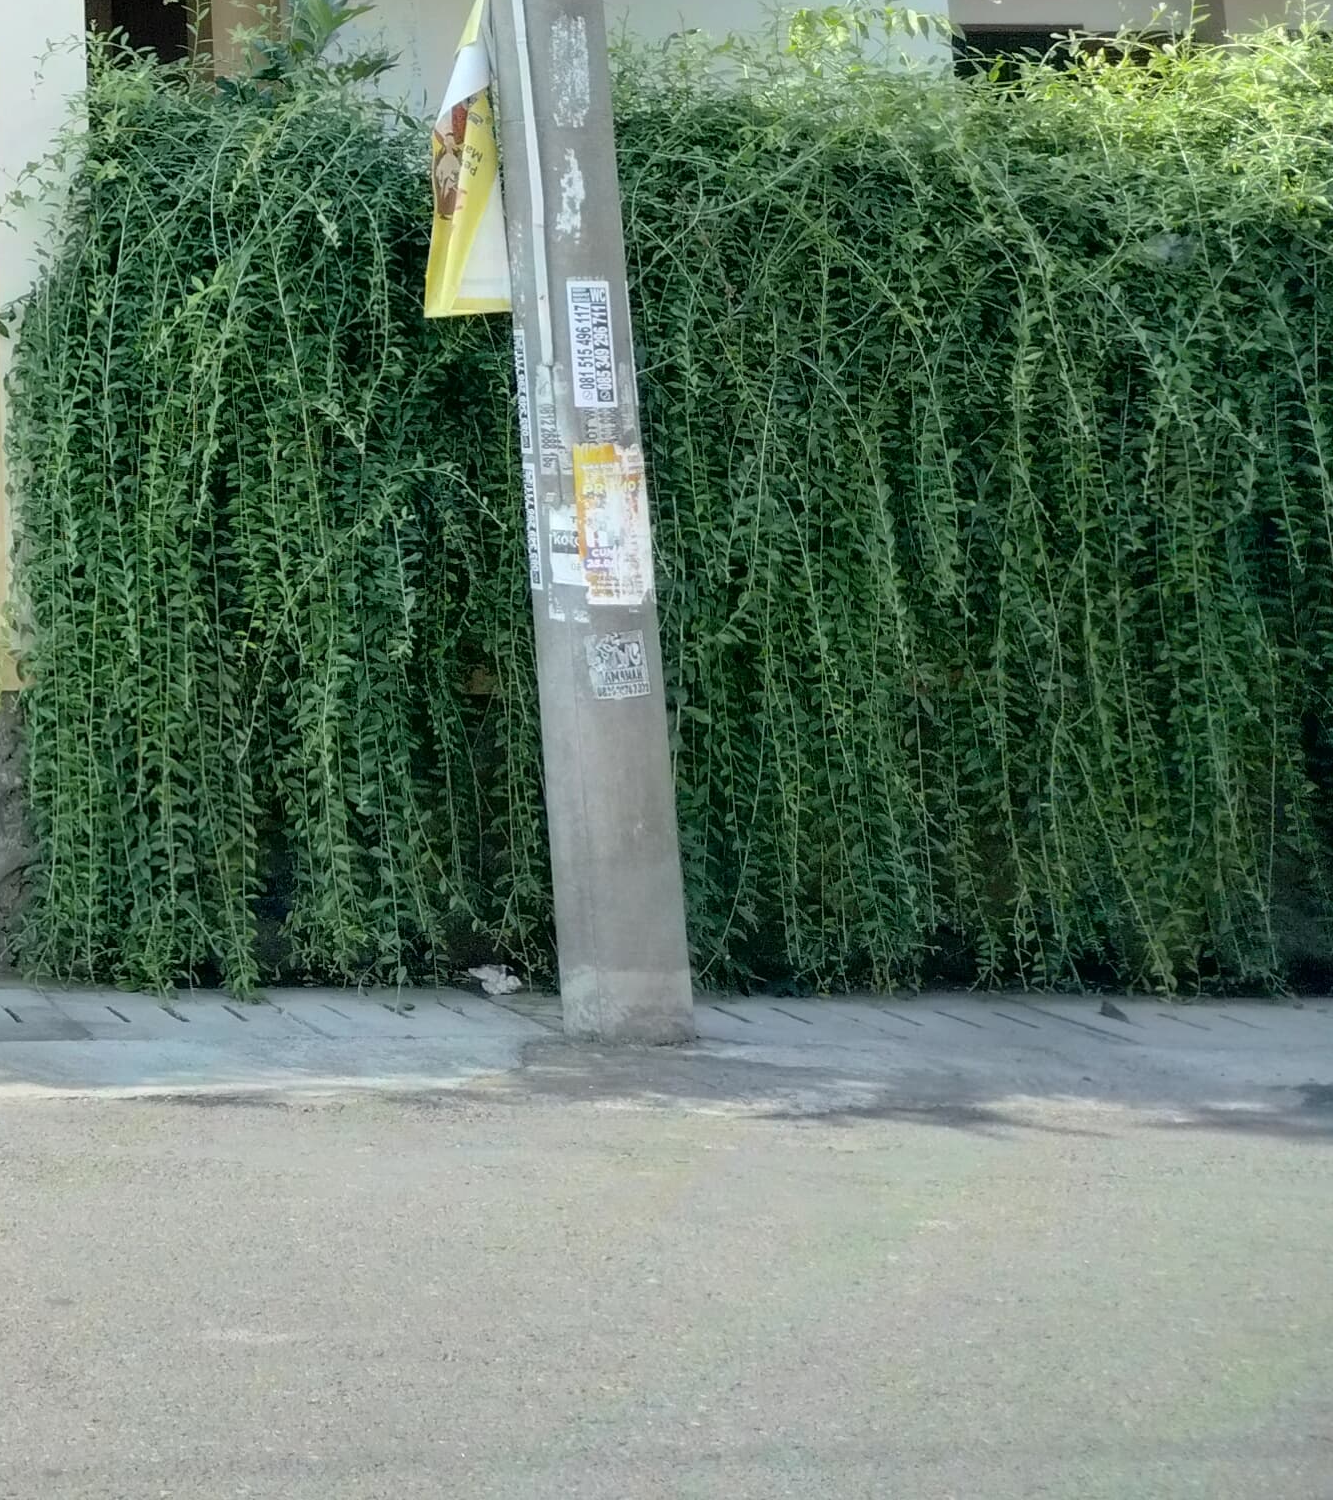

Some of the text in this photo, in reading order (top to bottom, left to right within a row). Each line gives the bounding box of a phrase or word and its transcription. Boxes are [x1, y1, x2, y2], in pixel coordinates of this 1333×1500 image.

[574, 304, 590, 324] 117
[592, 304, 608, 324] 711
[575, 327, 592, 347] 496
[593, 325, 609, 347] 296
[578, 348, 594, 368] 515
[595, 348, 611, 370] 349
[579, 372, 596, 390] 081
[596, 370, 613, 390] 085
